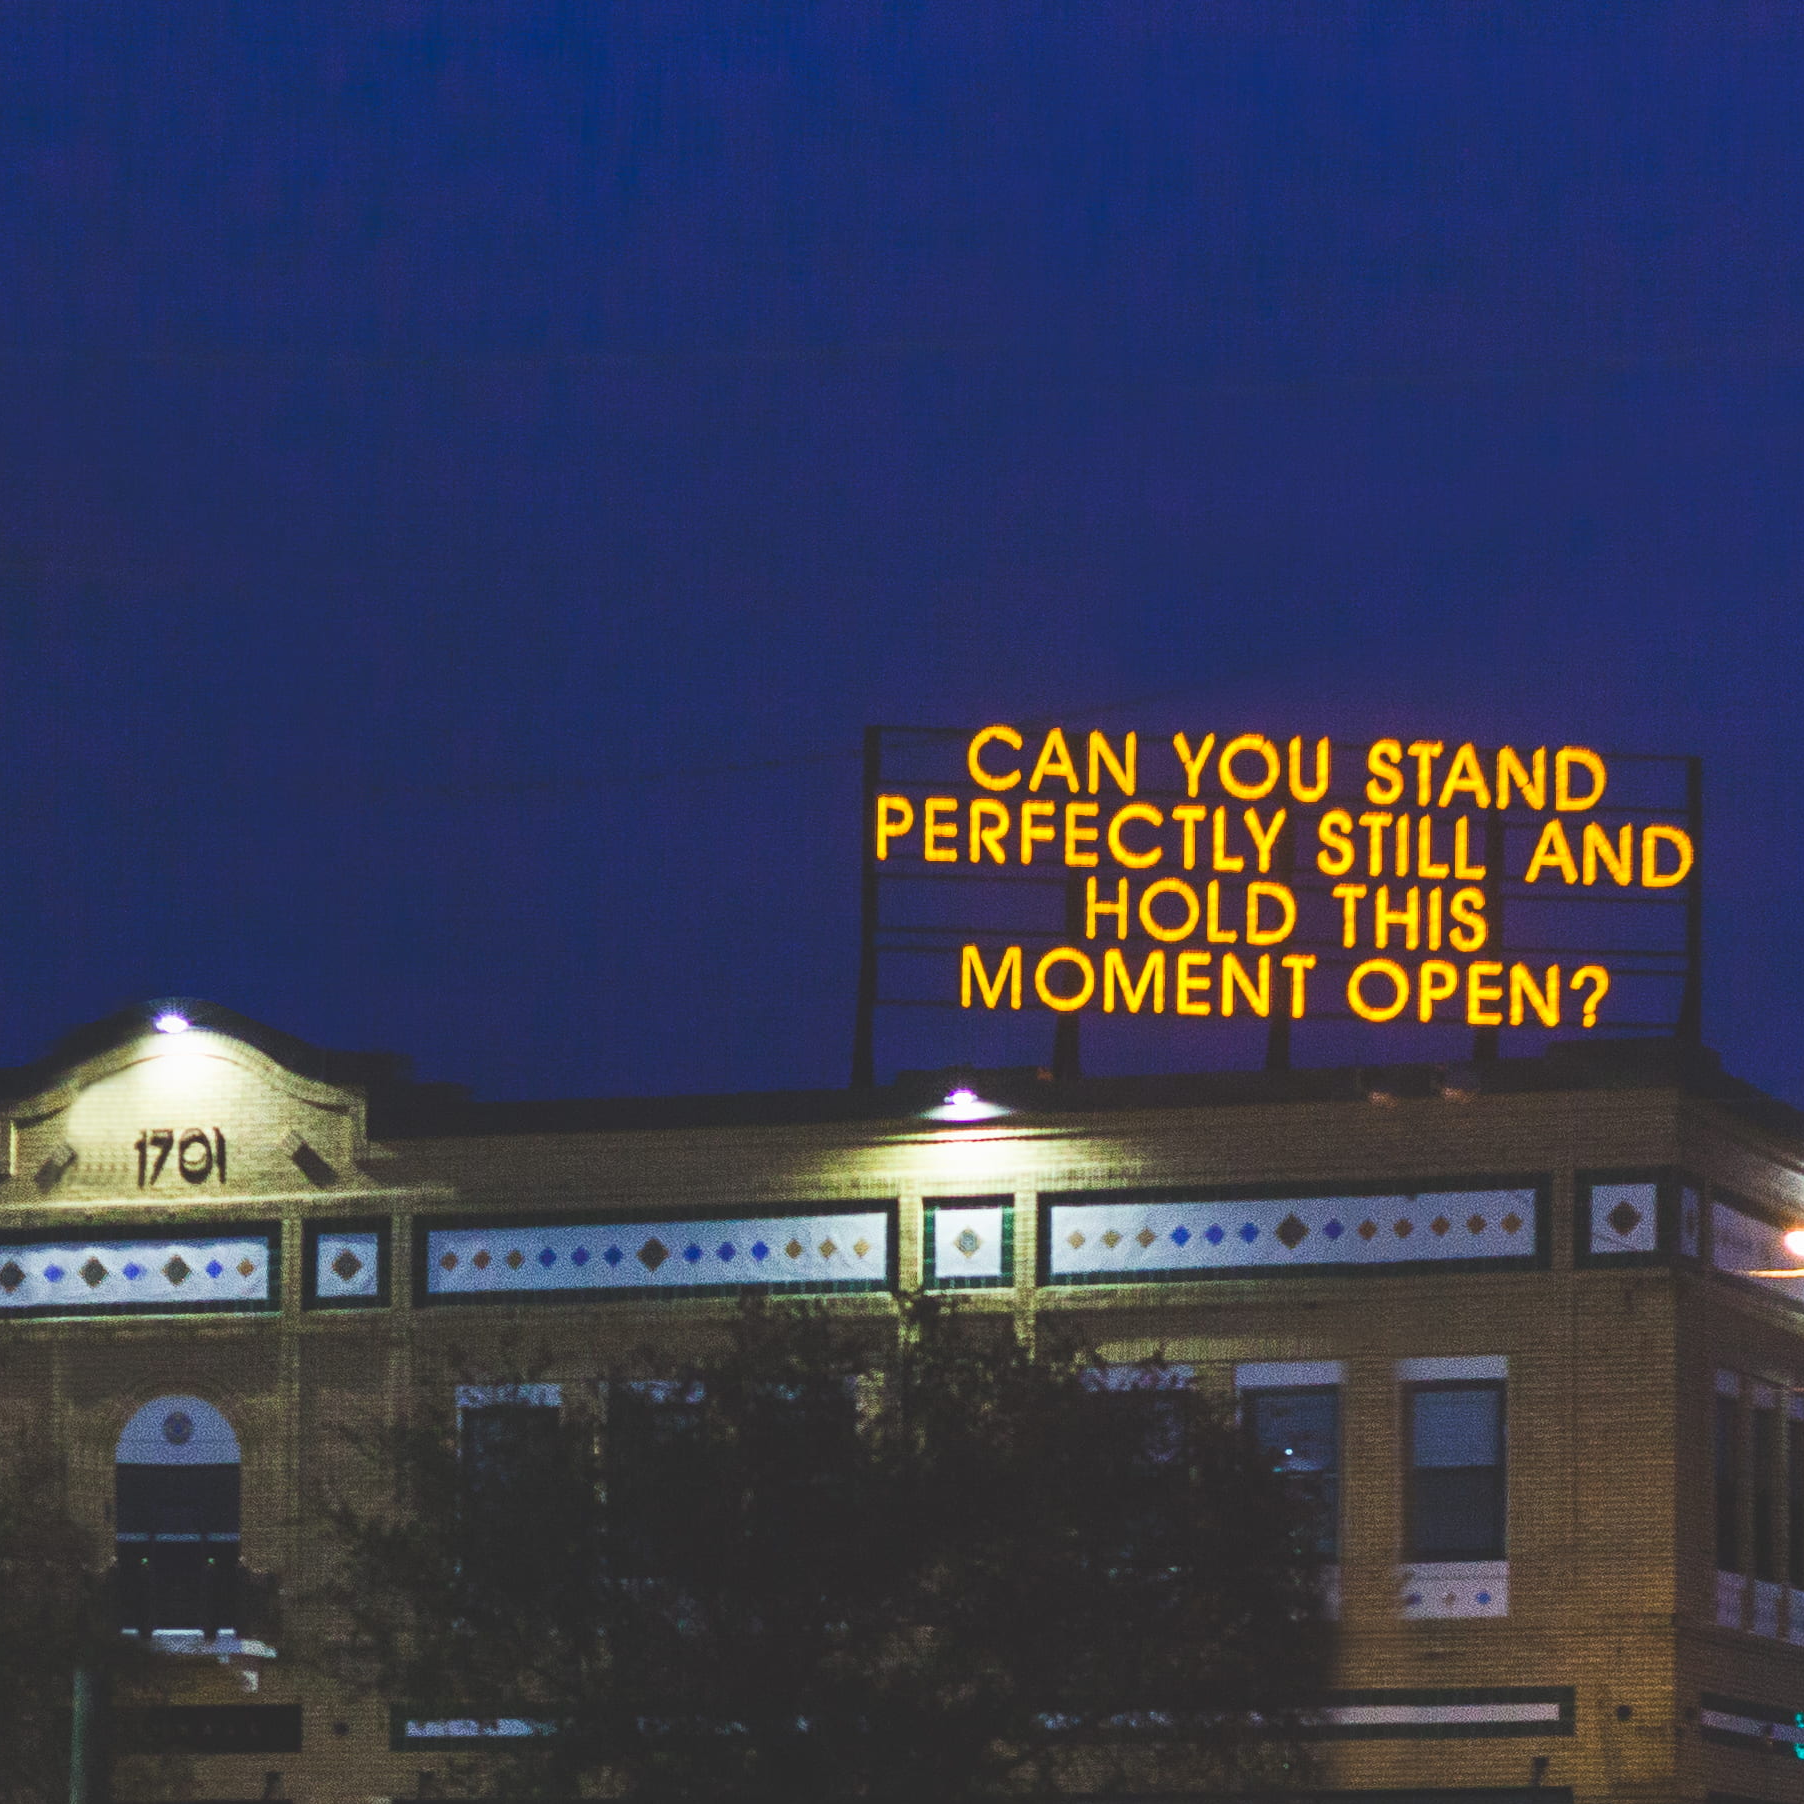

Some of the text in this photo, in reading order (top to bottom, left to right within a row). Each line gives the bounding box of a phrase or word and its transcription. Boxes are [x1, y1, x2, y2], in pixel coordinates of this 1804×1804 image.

[968, 724, 1607, 811] CAN YOU STAND
[877, 794, 1694, 887] PERFECTLY STILL AND
[1086, 876, 1488, 952] HOLD THIS
[961, 944, 1609, 1028] MOMENT OPEN?
[134, 1127, 228, 1189] 1701
